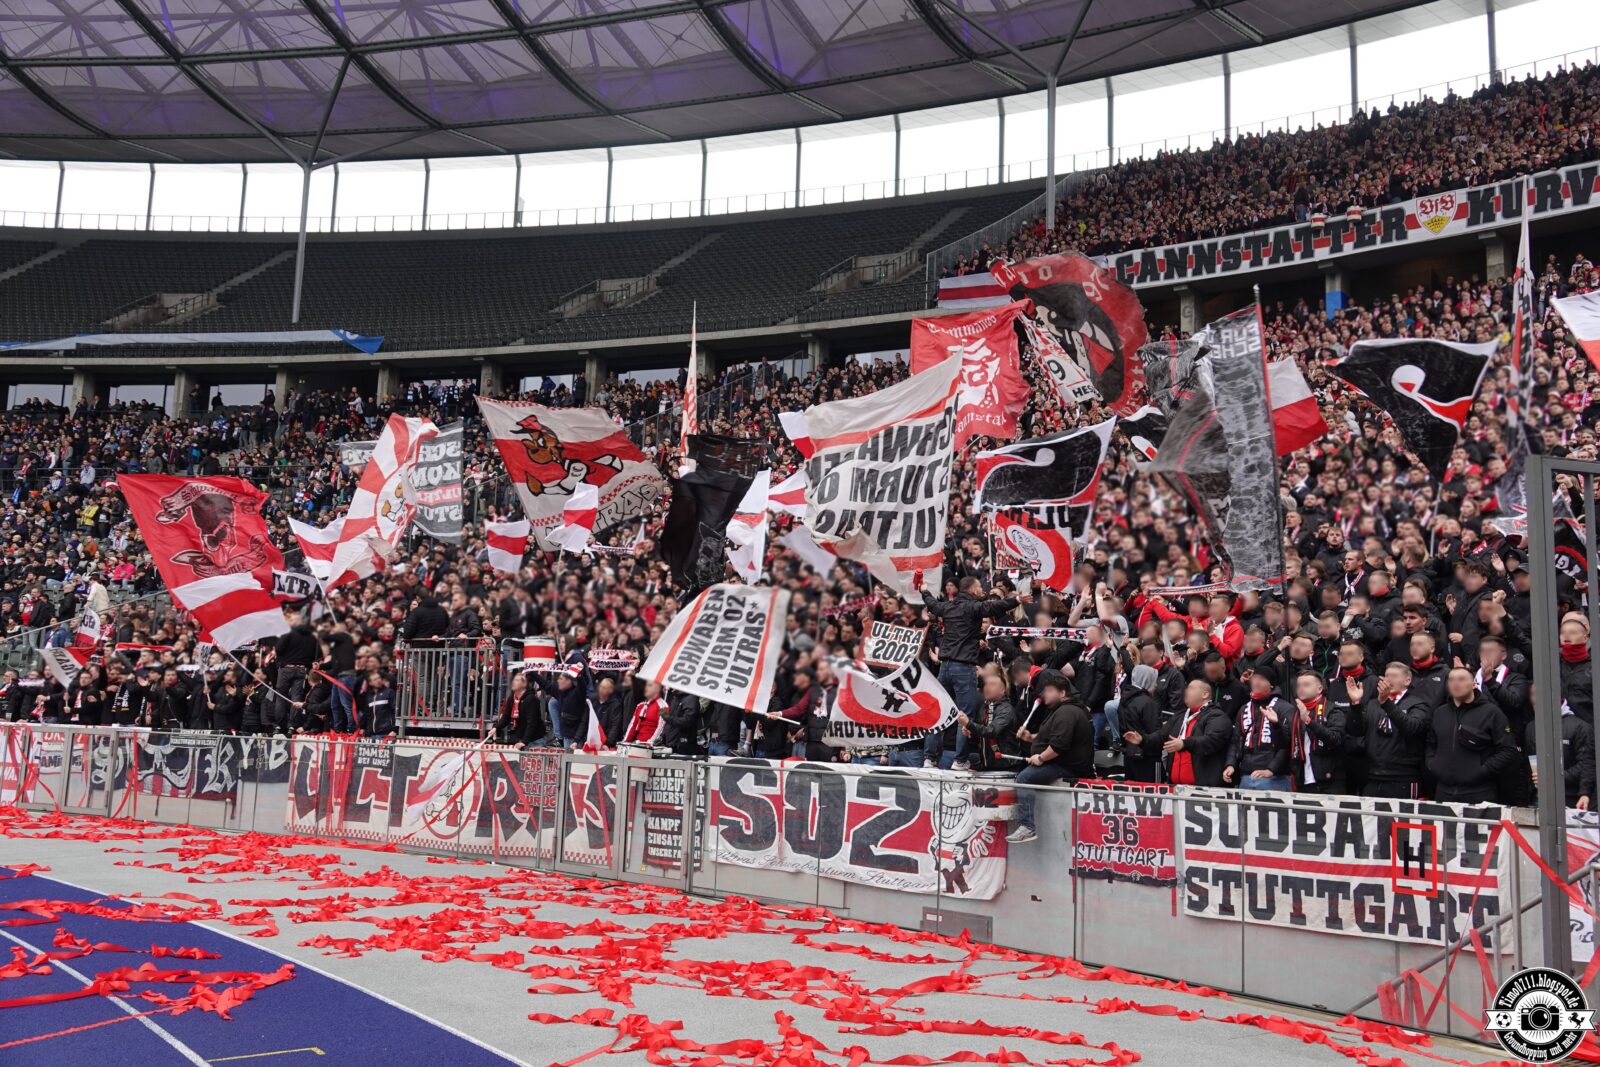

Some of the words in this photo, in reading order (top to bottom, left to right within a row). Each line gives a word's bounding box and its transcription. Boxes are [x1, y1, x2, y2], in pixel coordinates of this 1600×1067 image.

[1115, 206, 1408, 284] CANNSTATTER
[667, 589, 726, 686] SCHWABEN
[696, 627, 739, 690] STURM
[725, 611, 766, 688] ULTRAS
[358, 757, 370, 765] BEI
[359, 746, 390, 758] IMMER
[648, 816, 681, 831] KAMPF
[1074, 782, 1170, 818] CREW
[1077, 842, 1170, 867] STUTTGART
[1101, 814, 1140, 847] 36
[1185, 790, 1502, 870] SÜDBANDE
[1185, 865, 1501, 949] STUTTGART
